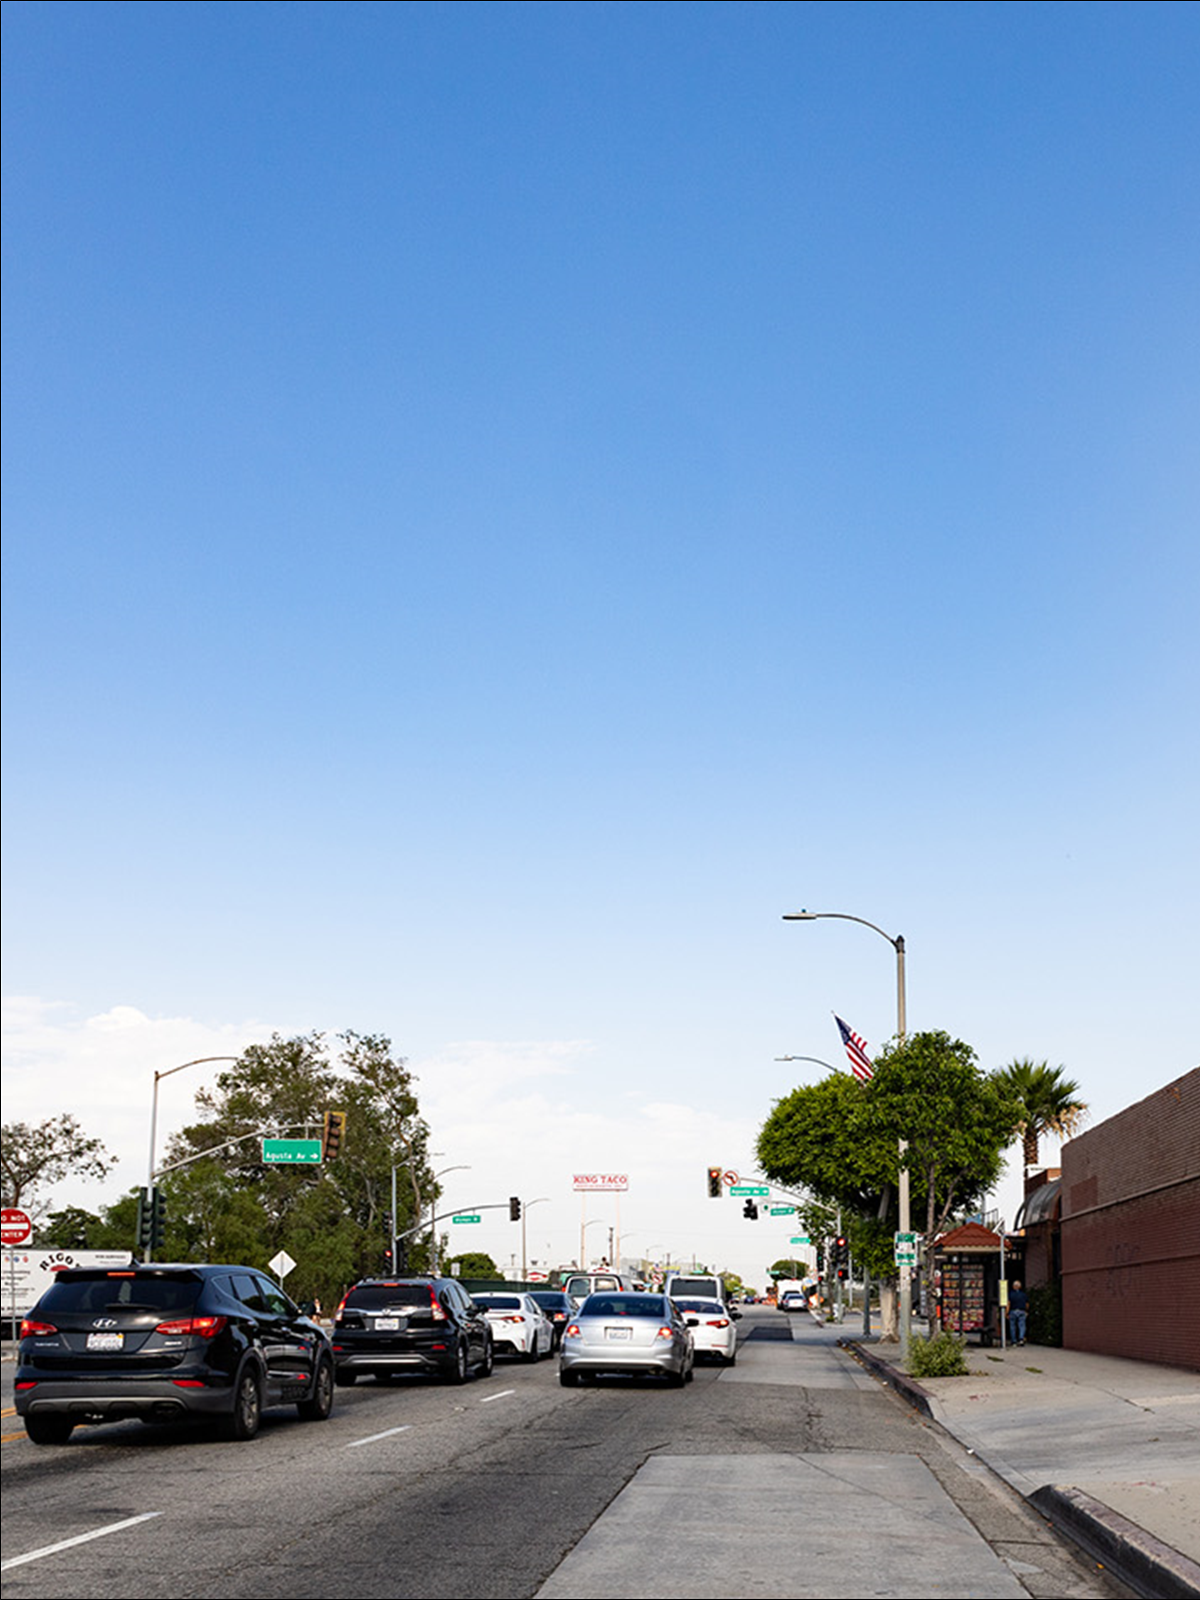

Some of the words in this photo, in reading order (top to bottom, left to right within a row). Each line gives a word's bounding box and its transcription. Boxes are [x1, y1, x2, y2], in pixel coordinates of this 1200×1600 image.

[296, 1152, 305, 1160] Av
[573, 1175, 598, 1184] KING
[600, 1175, 627, 1184] TACO
[39, 1252, 80, 1271] RIGO
